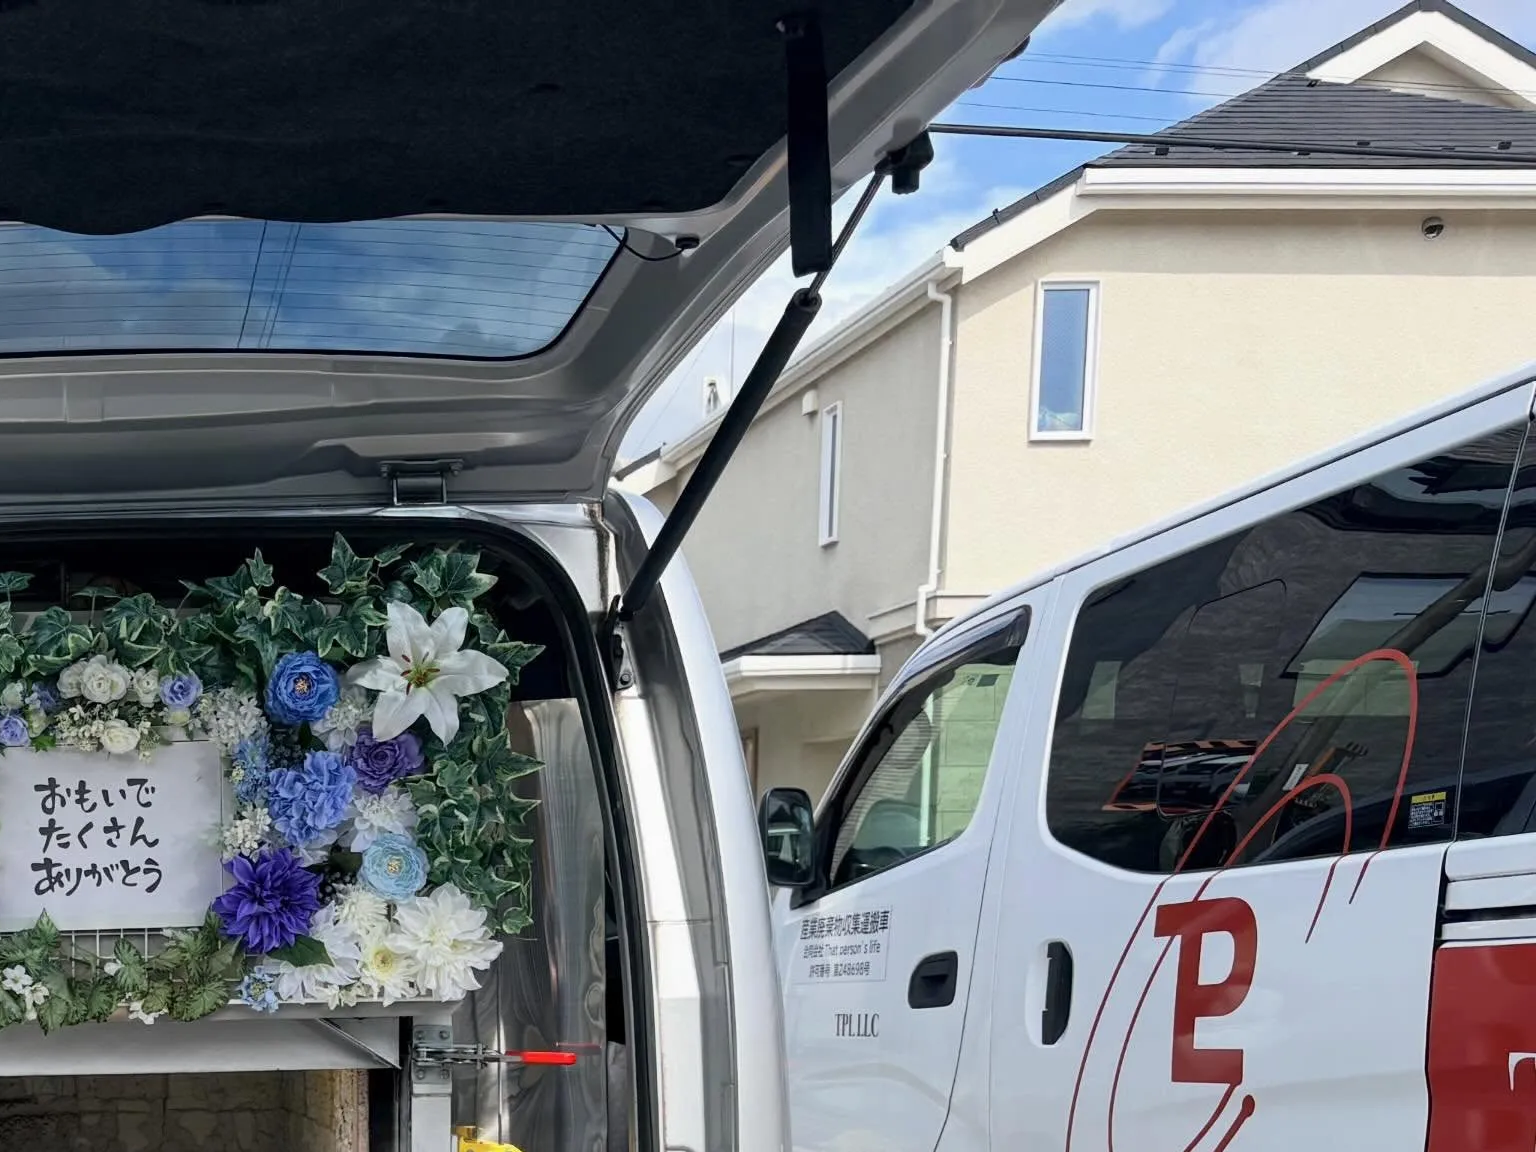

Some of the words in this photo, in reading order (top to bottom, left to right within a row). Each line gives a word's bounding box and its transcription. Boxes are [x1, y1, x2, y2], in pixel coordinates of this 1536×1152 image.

[34, 777, 156, 815] おもいで
[38, 816, 159, 853] たくさん
[31, 857, 162, 896] ありがとう
